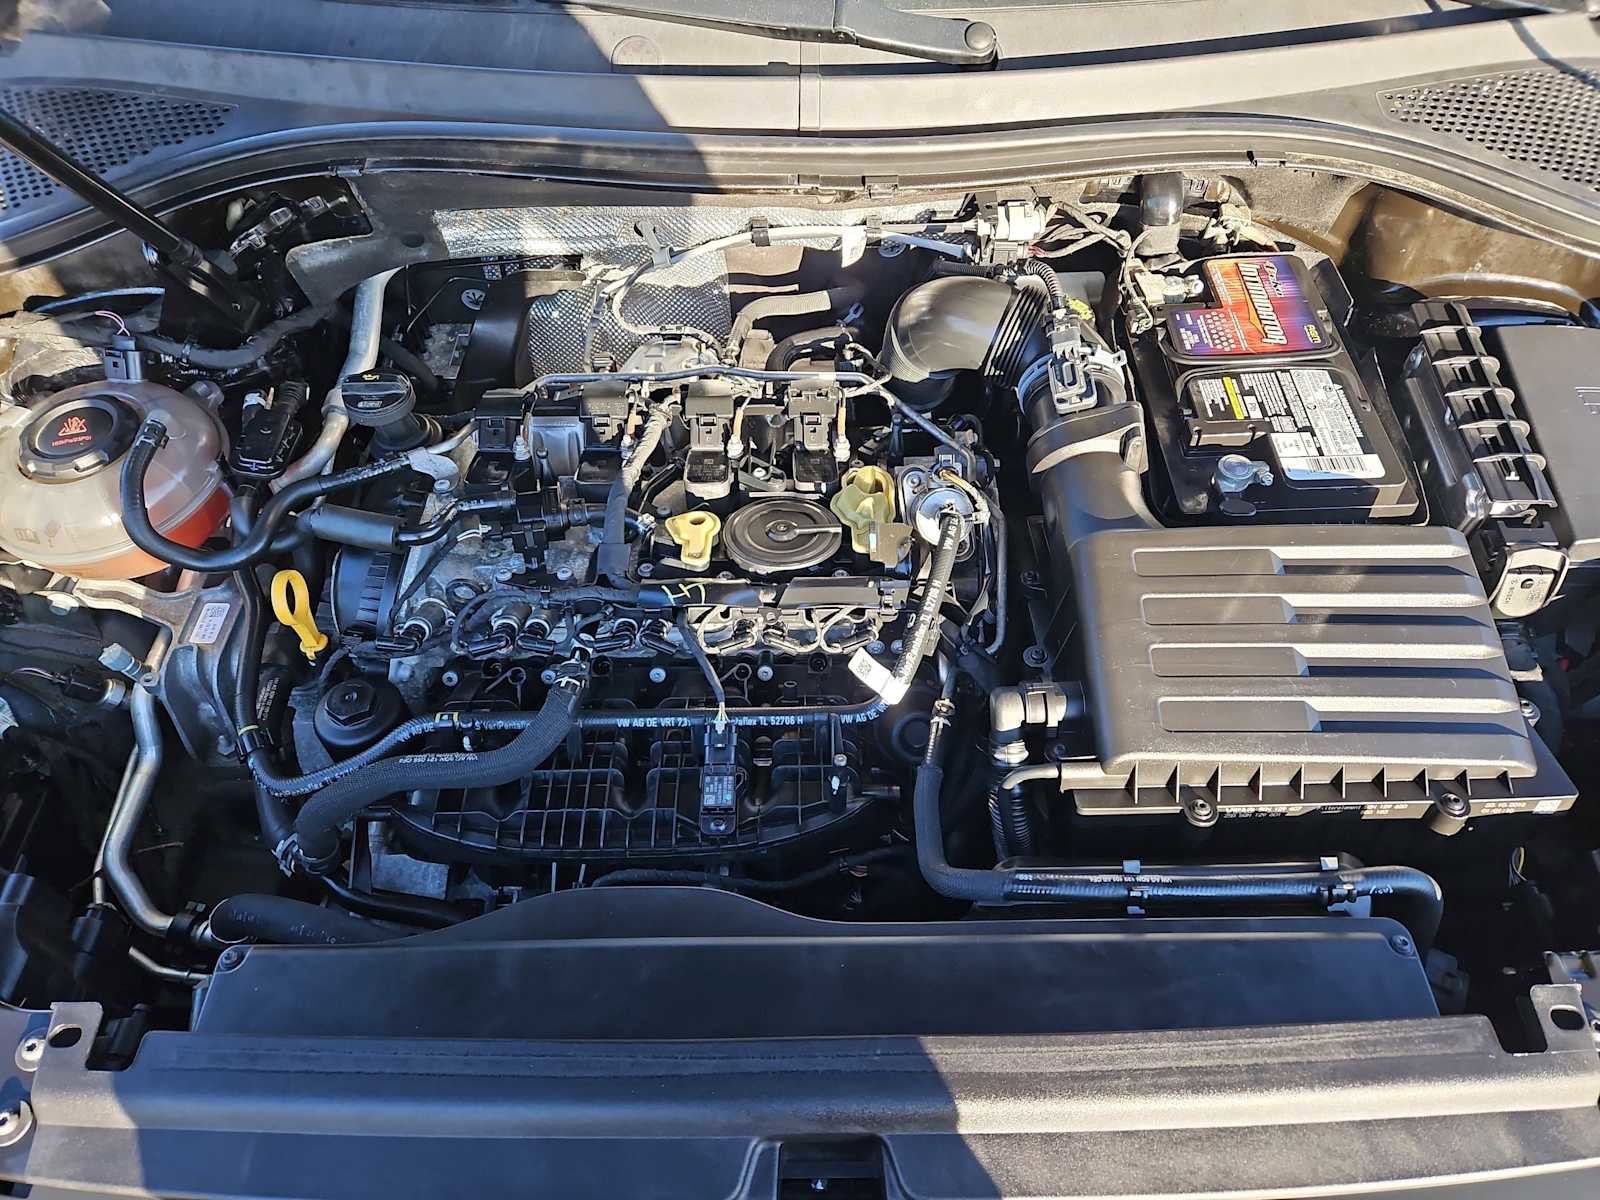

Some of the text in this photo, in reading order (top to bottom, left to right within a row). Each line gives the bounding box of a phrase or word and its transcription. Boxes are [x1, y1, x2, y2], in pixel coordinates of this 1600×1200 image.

[616, 718, 630, 728] VW
[632, 718, 645, 728] AG
[646, 717, 658, 728] DE
[660, 717, 676, 728] VRT
[770, 715, 795, 726] 52706
[797, 715, 804, 725] H
